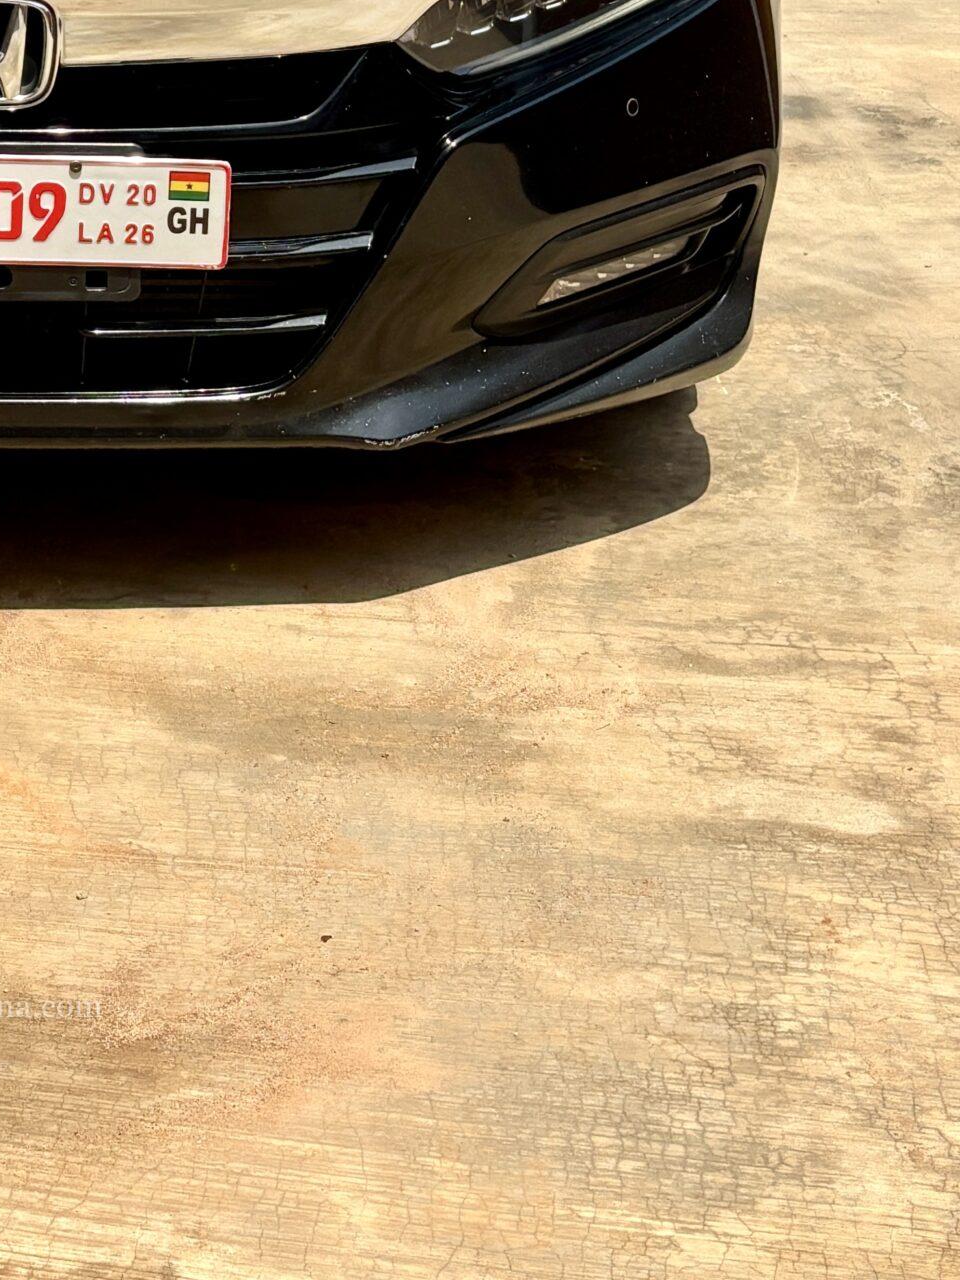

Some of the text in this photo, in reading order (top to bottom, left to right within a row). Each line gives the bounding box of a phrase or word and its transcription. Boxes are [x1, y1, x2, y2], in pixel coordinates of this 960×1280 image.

[79, 184, 156, 205] DV 20
[168, 207, 209, 234] GH
[79, 224, 154, 244] LA 26
